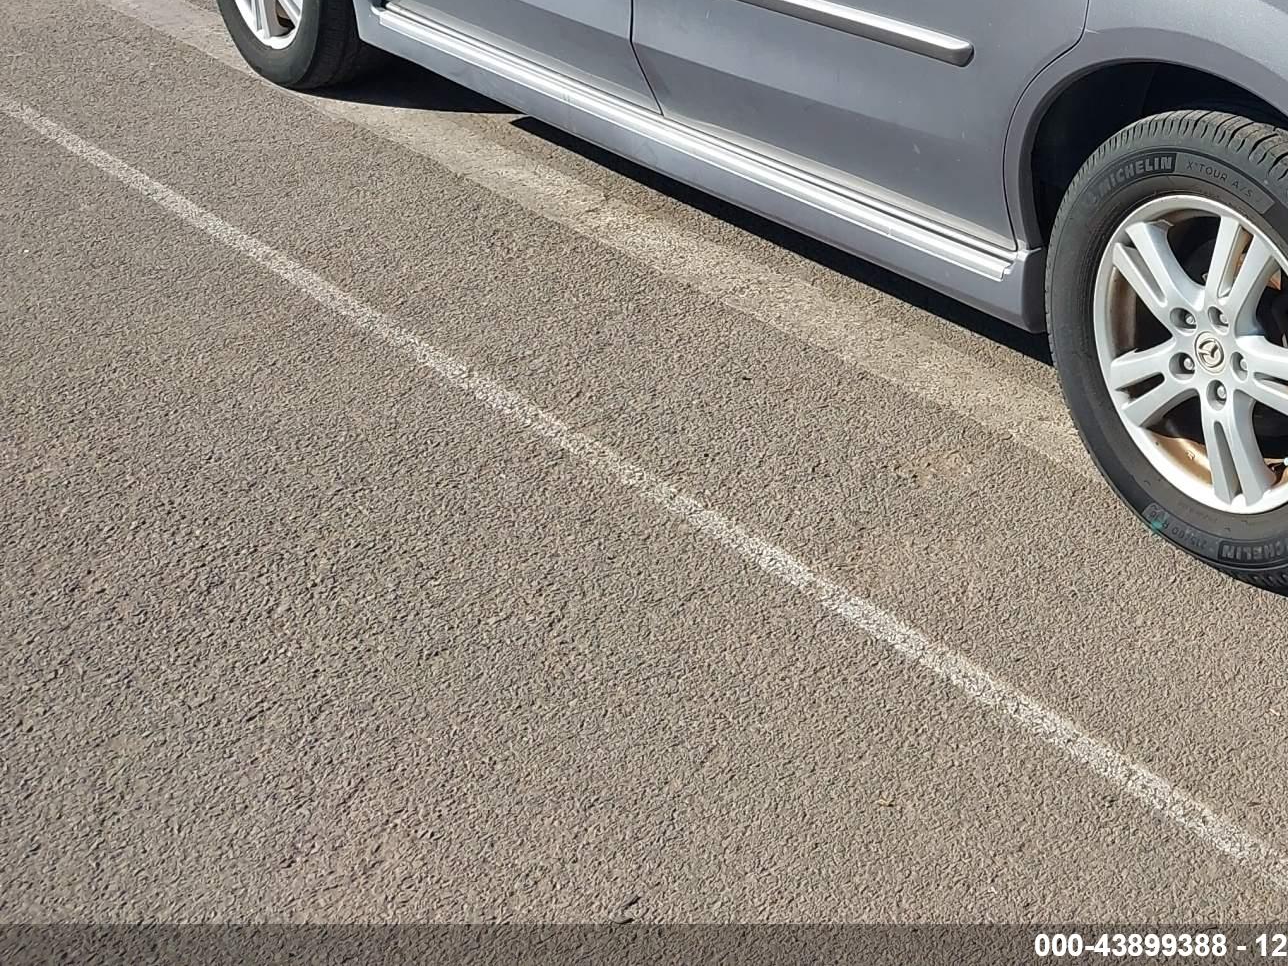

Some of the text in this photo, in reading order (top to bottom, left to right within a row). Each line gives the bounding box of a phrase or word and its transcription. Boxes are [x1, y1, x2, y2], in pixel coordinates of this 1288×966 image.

[1097, 156, 1173, 198] MICHELIN
[1199, 162, 1229, 183] TOUR
[1231, 180, 1254, 197] A/S
